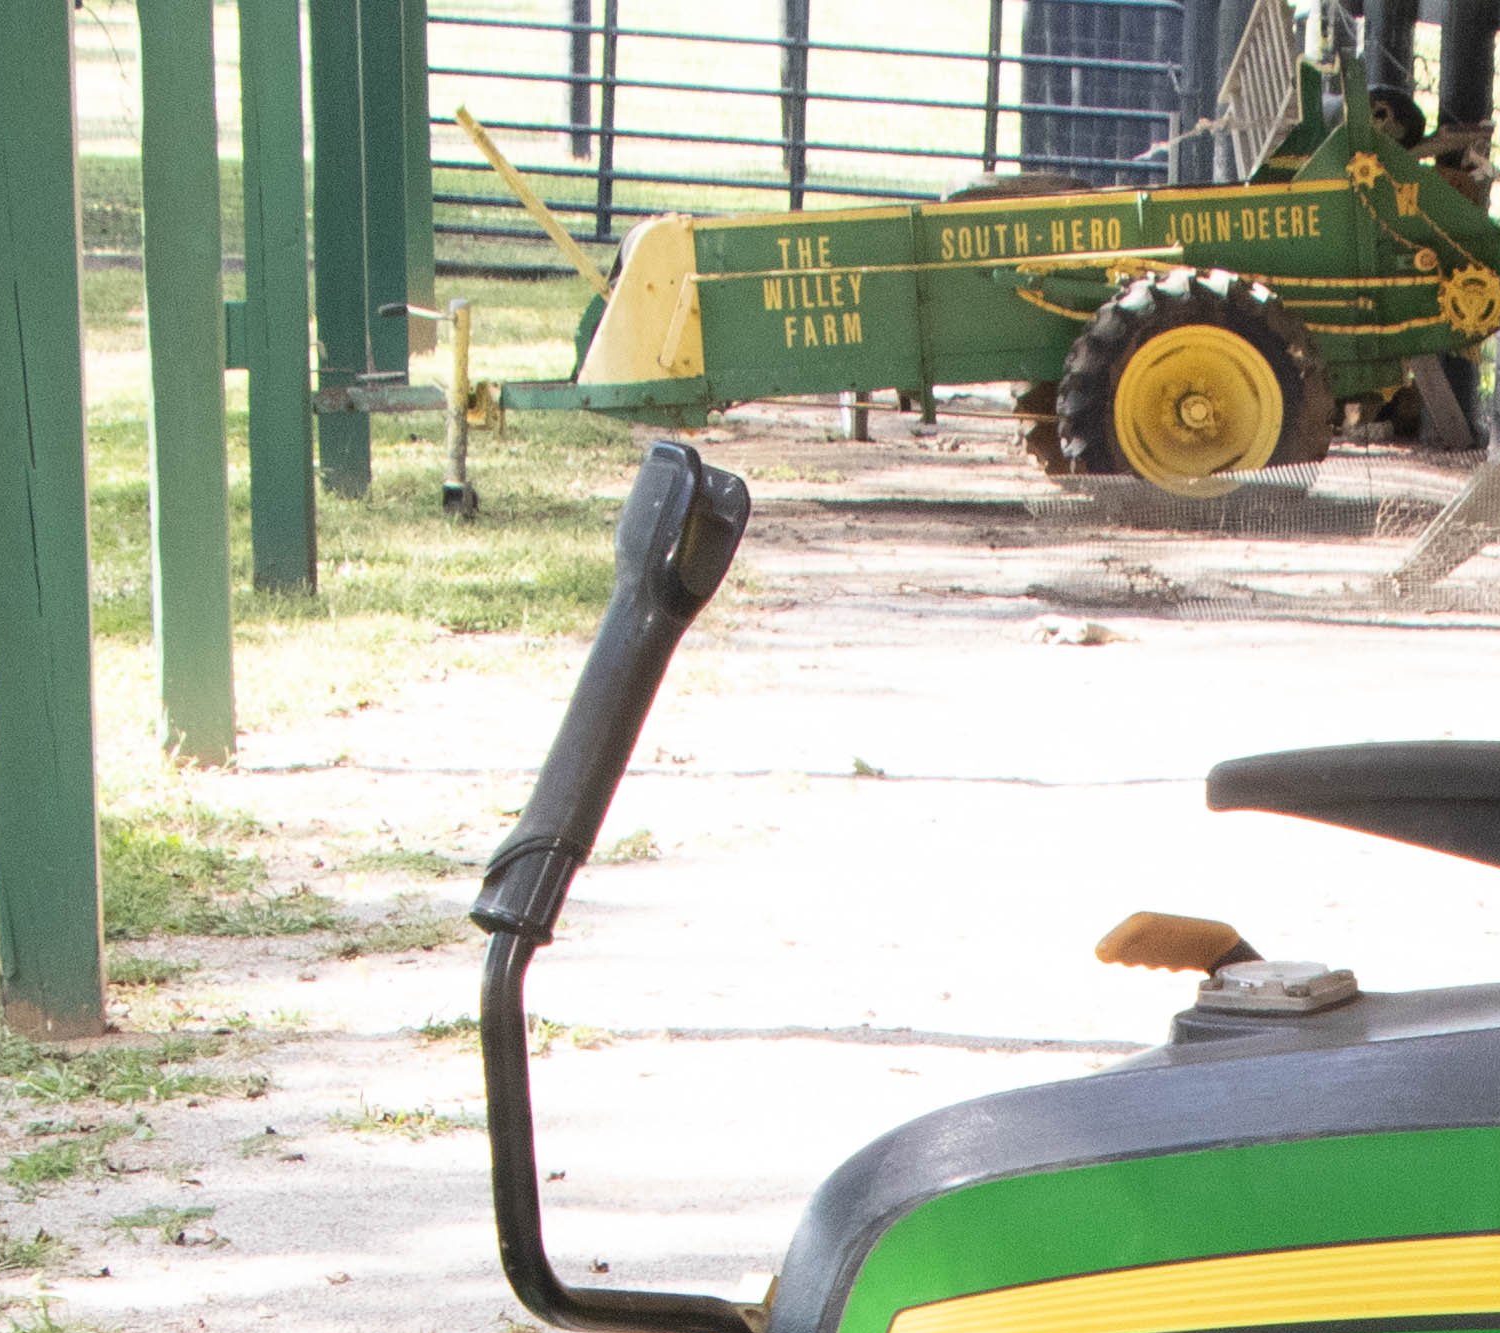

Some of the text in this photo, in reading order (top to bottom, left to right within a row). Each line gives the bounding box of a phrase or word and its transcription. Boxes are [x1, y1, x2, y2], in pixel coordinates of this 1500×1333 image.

[940, 205, 1321, 260] SOUTH-HERO JOHN-DEERE
[777, 236, 833, 270] THE
[763, 272, 863, 311] WILLEY
[784, 312, 863, 349] FARM
